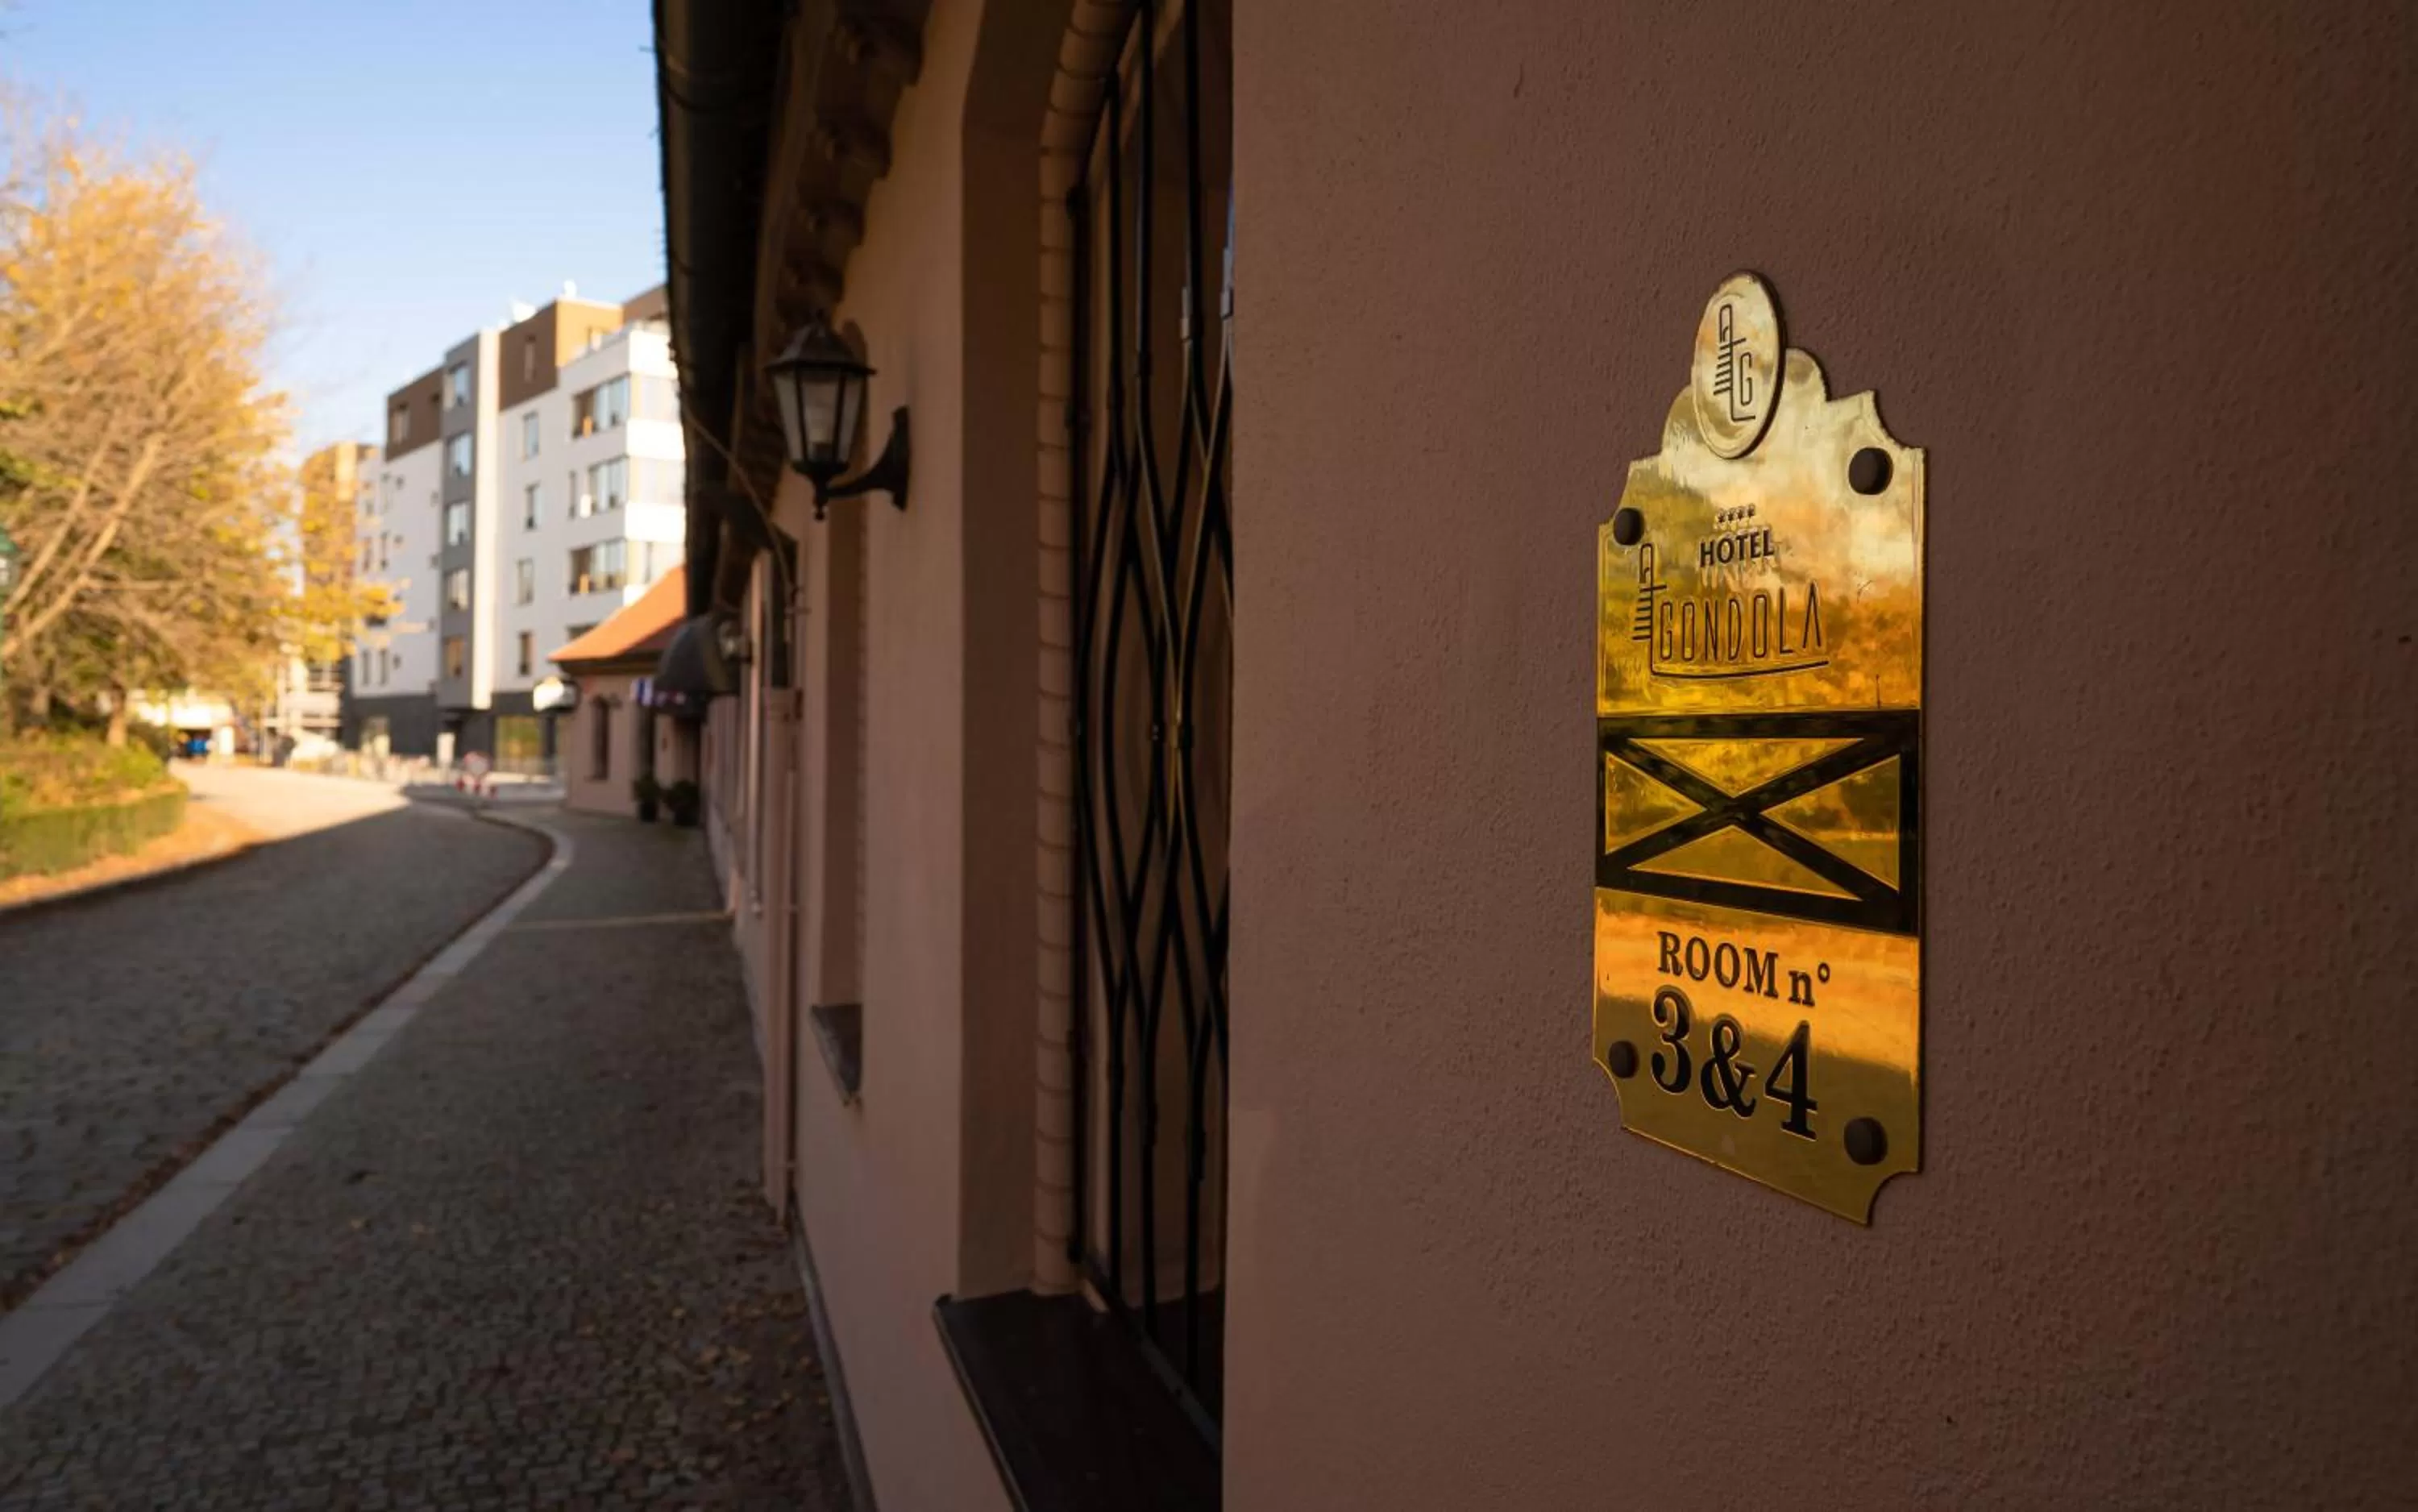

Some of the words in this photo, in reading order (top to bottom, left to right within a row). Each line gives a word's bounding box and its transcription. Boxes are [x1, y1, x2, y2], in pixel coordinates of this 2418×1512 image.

[1700, 528, 1774, 568] HOTEL
[1659, 582, 1822, 662] GONDOLA
[1656, 931, 1779, 999] ROOM
[1650, 986, 1818, 1142] 3&4
